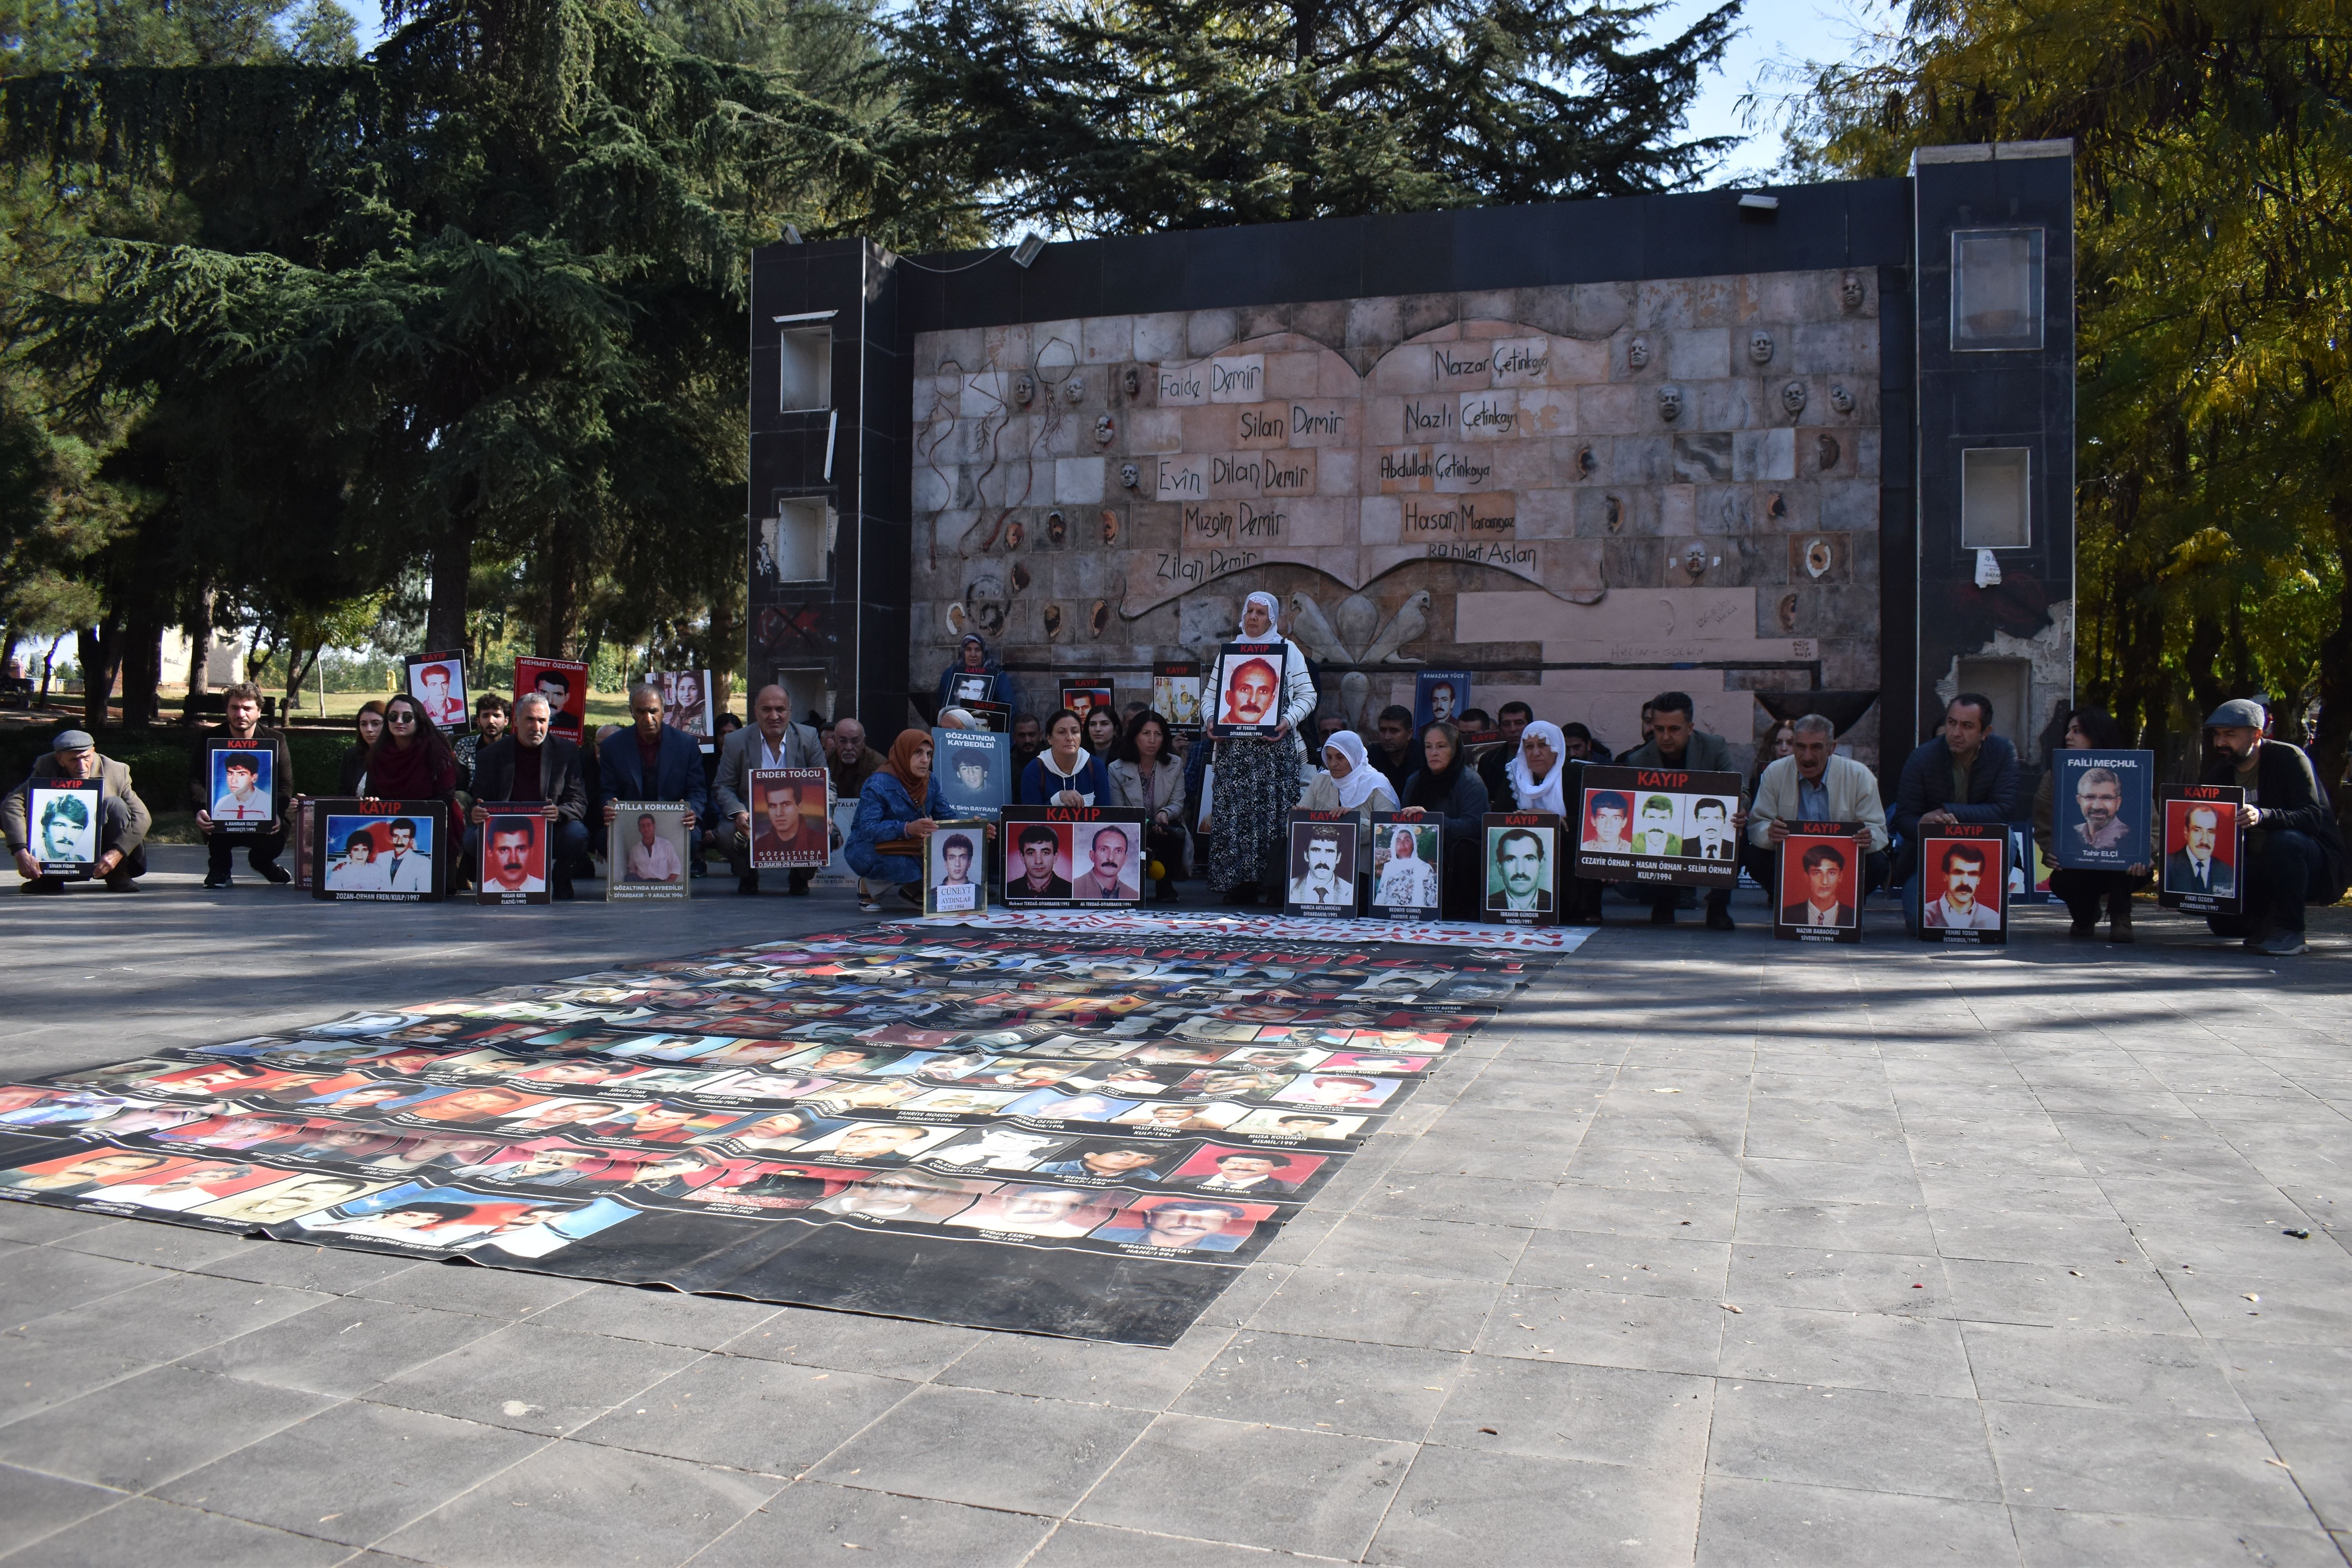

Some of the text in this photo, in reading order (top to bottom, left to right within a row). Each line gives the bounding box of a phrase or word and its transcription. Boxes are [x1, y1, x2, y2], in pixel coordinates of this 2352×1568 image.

[1436, 350, 1489, 381] Nazar
[1213, 364, 1260, 394] Demir
[1241, 406, 1344, 440] Şilan Demir
[1406, 401, 1451, 434] Nazlı
[1381, 453, 1490, 484] Abdullah Çetinkaya
[1160, 456, 1308, 494] Evîn Dilan Demir
[1240, 502, 1286, 536] Demir
[1406, 502, 1515, 532] Hasan Marangoz
[1487, 542, 1536, 571] Aslan
[1156, 550, 1257, 583] Zilan Demir
[421, 653, 446, 662] KAYIP
[521, 659, 584, 671] MEHMET ÖZDEMİR
[974, 701, 996, 710] KAYIP
[946, 732, 996, 742] GÖZALTINDA
[1472, 733, 1497, 742] KAYIP
[227, 740, 258, 748] KAYIP
[947, 739, 994, 749] KAYBEDİLDİ
[2068, 758, 2138, 768] FAİLİ MEÇHUL
[789, 769, 820, 777] TOĞCU
[51, 780, 83, 788] KAYIP
[1638, 771, 1689, 788] KAYIP
[2184, 787, 2220, 798] KAYIP
[359, 802, 402, 814] KAYIP
[1046, 808, 1100, 821] KAYIP
[1505, 815, 1539, 825] KAYIP
[1804, 823, 1841, 834] KAYIP
[1945, 826, 1984, 836] KAYIP
[1581, 856, 1732, 875] CEZAYİR ÖRHAN HASAN ÖRHAN SELİM ÖRHAN
[1638, 871, 1672, 881] KULP/1994
[941, 887, 971, 895] CÜNEYT
[2180, 902, 2218, 911] DİYARBAKIR/1997
[704, 1206, 754, 1214] HAZRO/1993
[345, 1234, 466, 1253] ZOZAN-ORHAN EREN/KULP/1997
[1118, 1243, 1157, 1251] İBRAHİM
[1126, 1248, 1176, 1258] HANİ/1994
